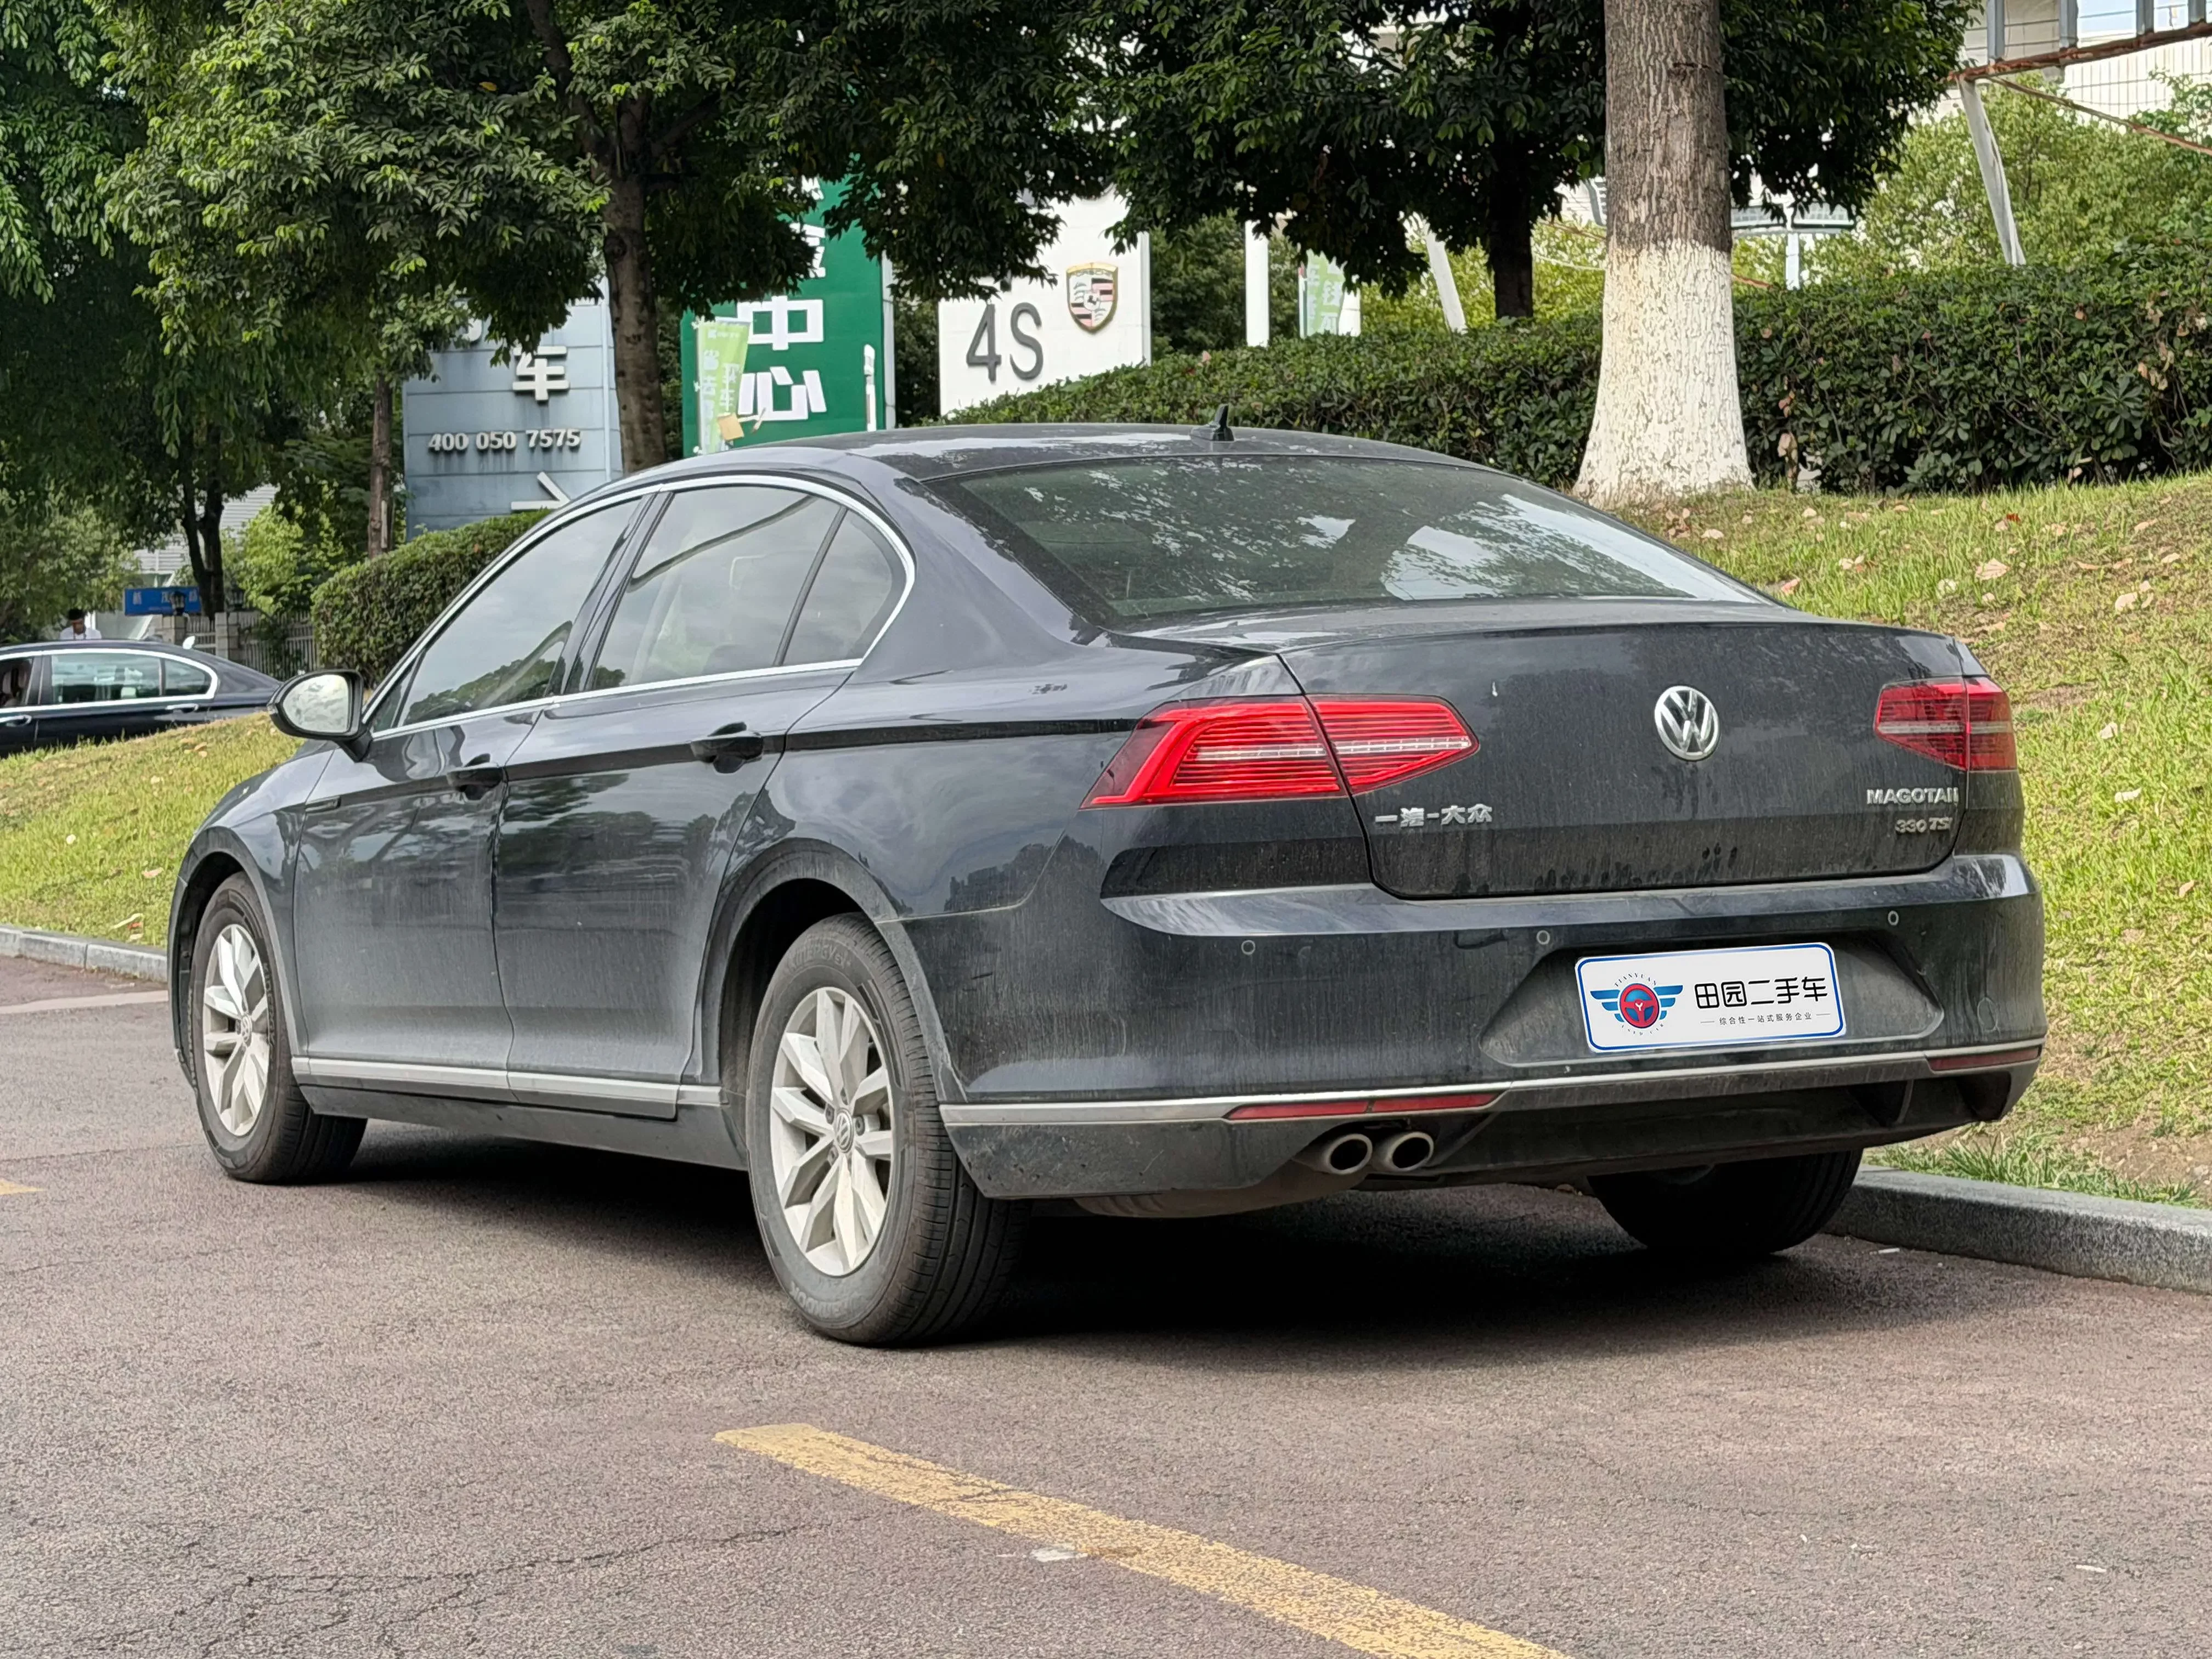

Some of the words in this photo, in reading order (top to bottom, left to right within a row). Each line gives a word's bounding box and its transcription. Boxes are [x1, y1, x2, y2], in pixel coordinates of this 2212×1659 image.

[966, 302, 1043, 382] 4S
[428, 432, 470, 452] 400
[476, 431, 517, 450] 050
[526, 428, 582, 449] 7575
[1694, 977, 1828, 1009] 田园二手车
[1719, 1012, 1813, 1025] 综合性一站式服务企业
